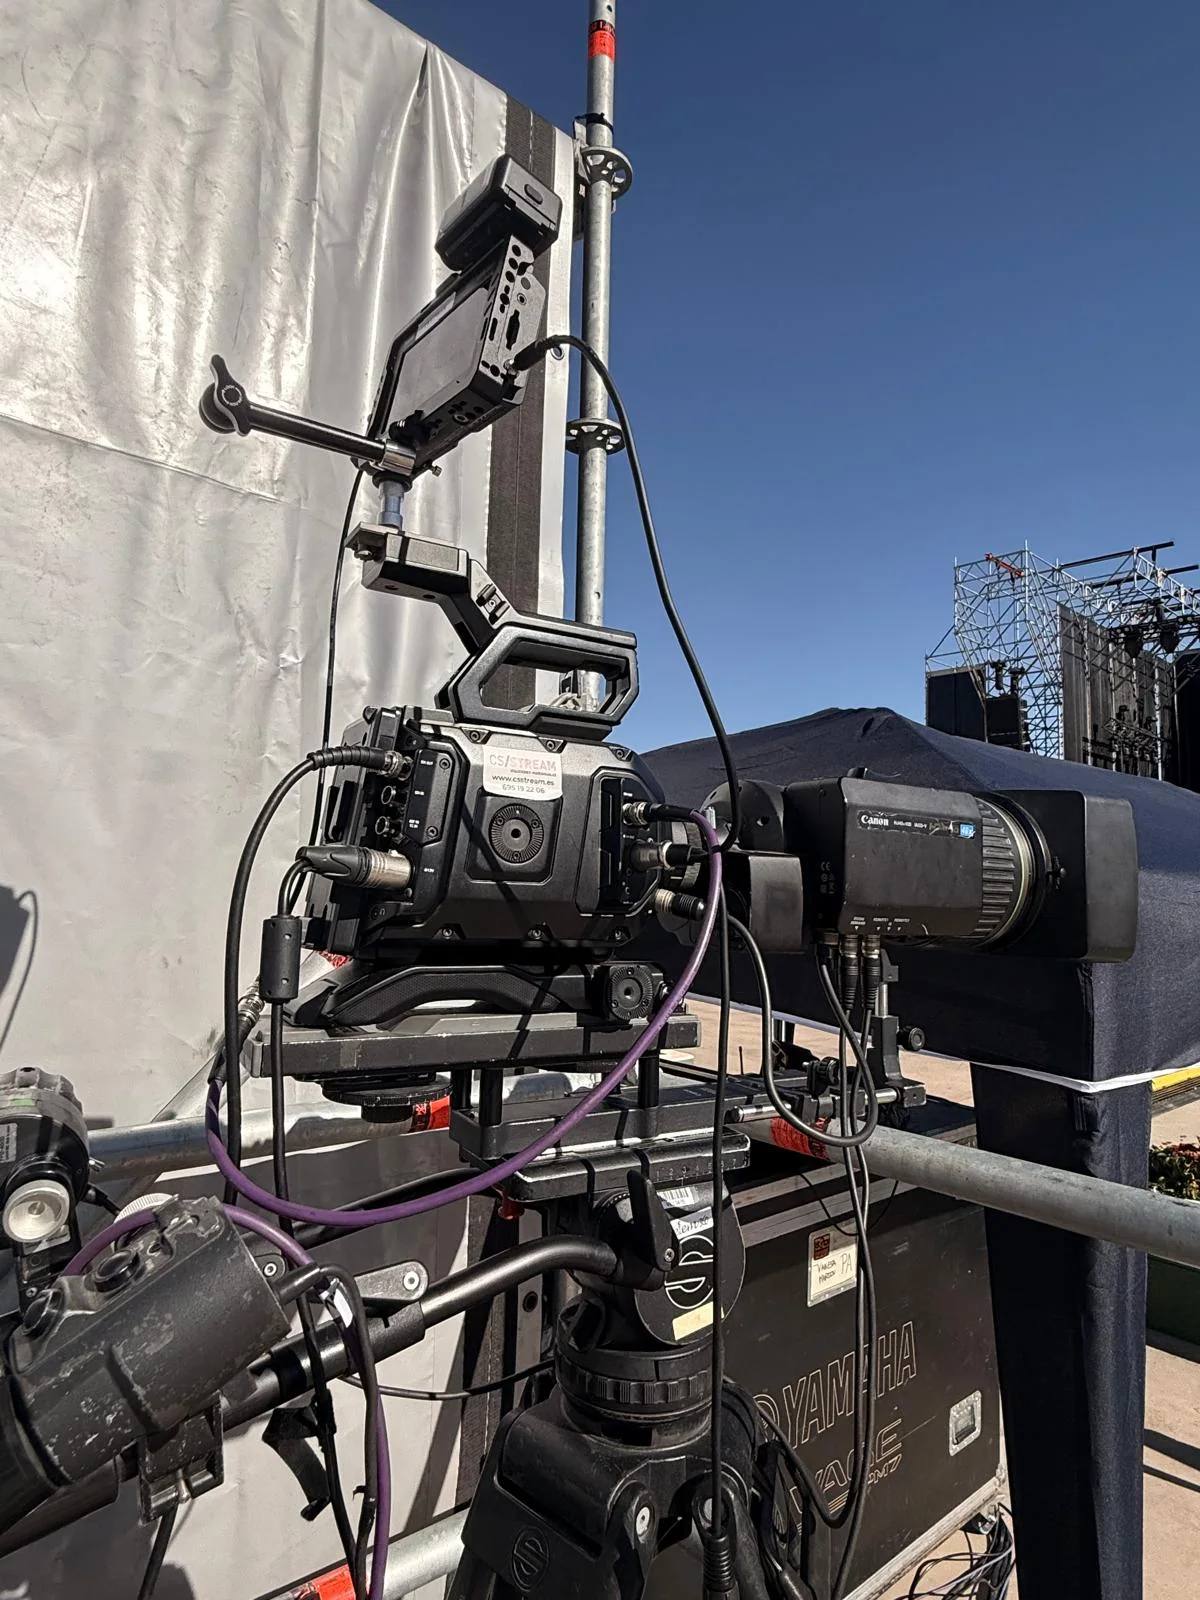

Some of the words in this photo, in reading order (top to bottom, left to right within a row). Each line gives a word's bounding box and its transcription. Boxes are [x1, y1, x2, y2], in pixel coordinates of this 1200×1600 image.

[489, 754, 557, 772] CS/STREAM
[492, 775, 555, 786] www.csstream.es
[860, 814, 889, 826] Canon
[840, 1252, 853, 1275] PA
